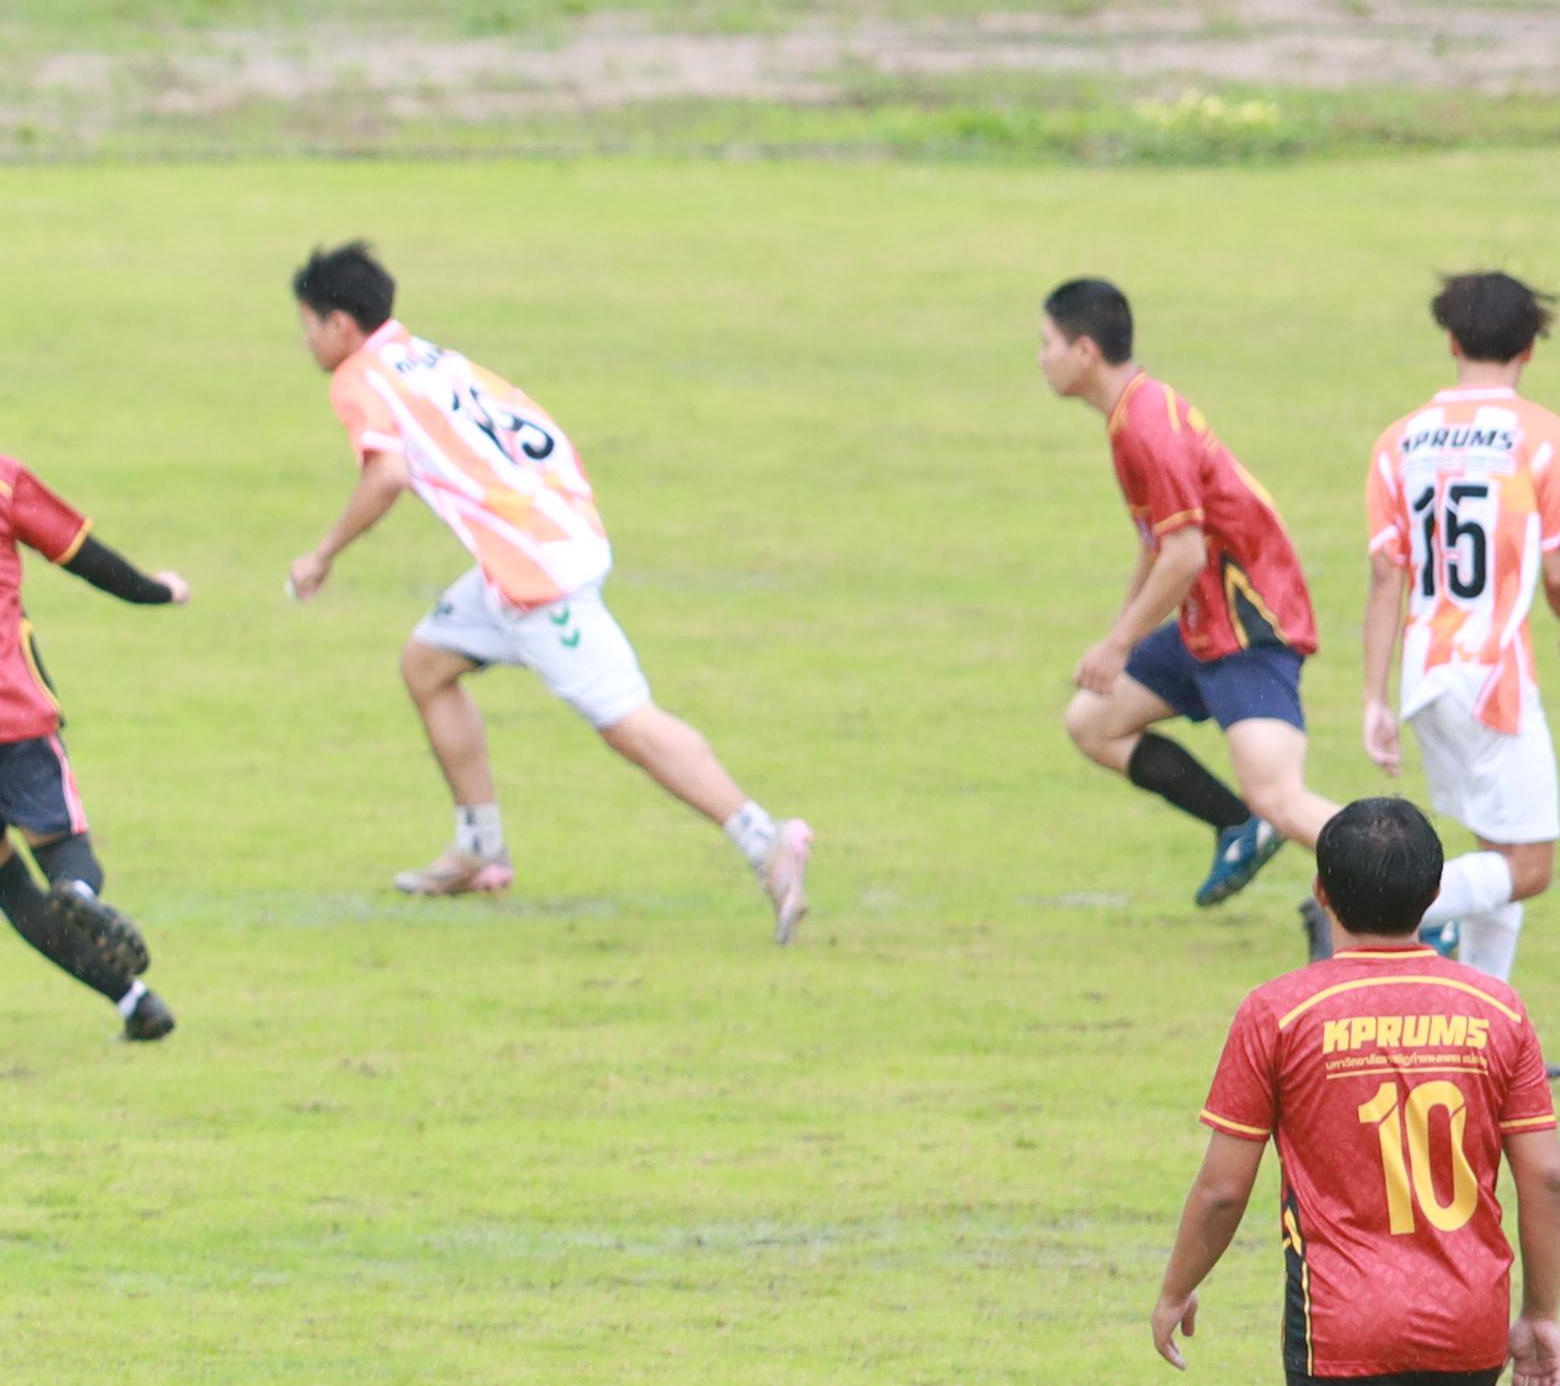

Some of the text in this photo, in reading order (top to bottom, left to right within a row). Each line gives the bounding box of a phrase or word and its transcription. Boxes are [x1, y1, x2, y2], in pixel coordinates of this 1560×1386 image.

[1413, 485, 1488, 598] 15
[1322, 1015, 1489, 1054] KPRUMS
[1358, 1080, 1479, 1235] 10
